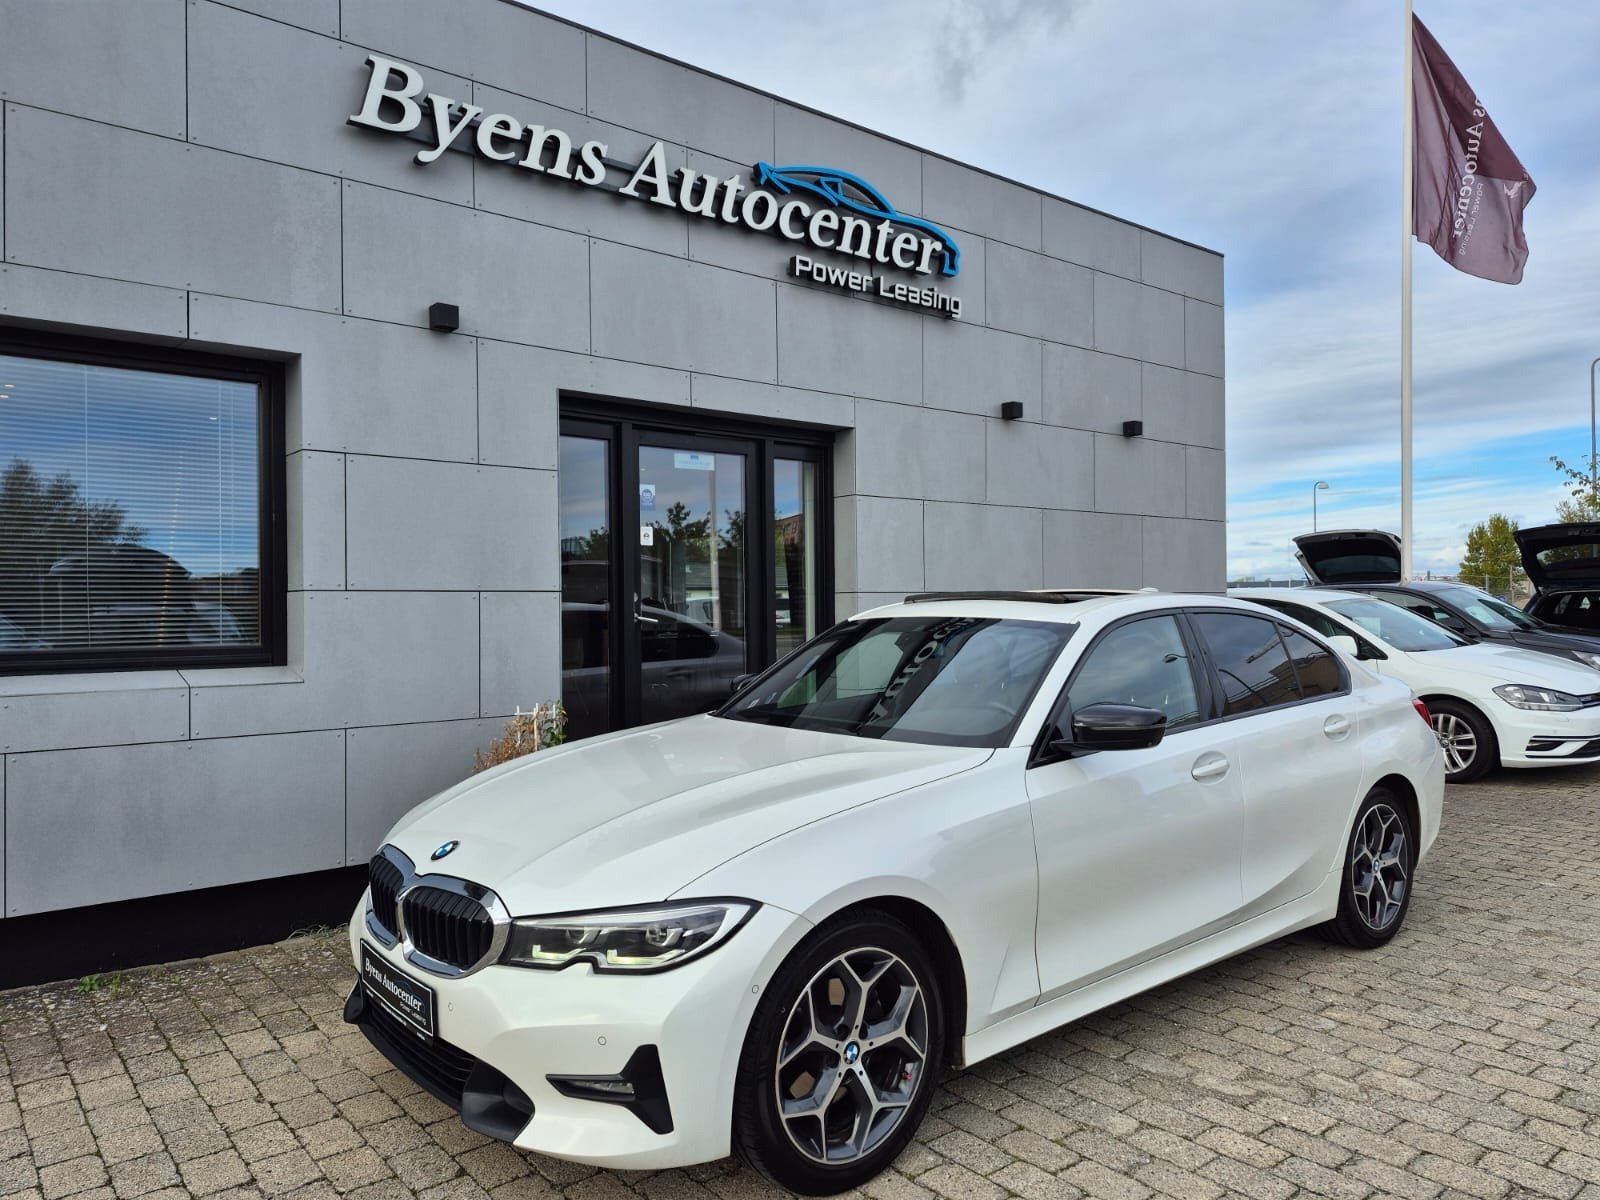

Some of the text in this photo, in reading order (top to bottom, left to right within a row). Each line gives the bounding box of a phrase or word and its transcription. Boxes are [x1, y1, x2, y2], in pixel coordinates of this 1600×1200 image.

[349, 55, 942, 275] Byens Autocenter
[795, 254, 962, 319] Power Leasing
[365, 957, 422, 1011] Byens Autocenter
